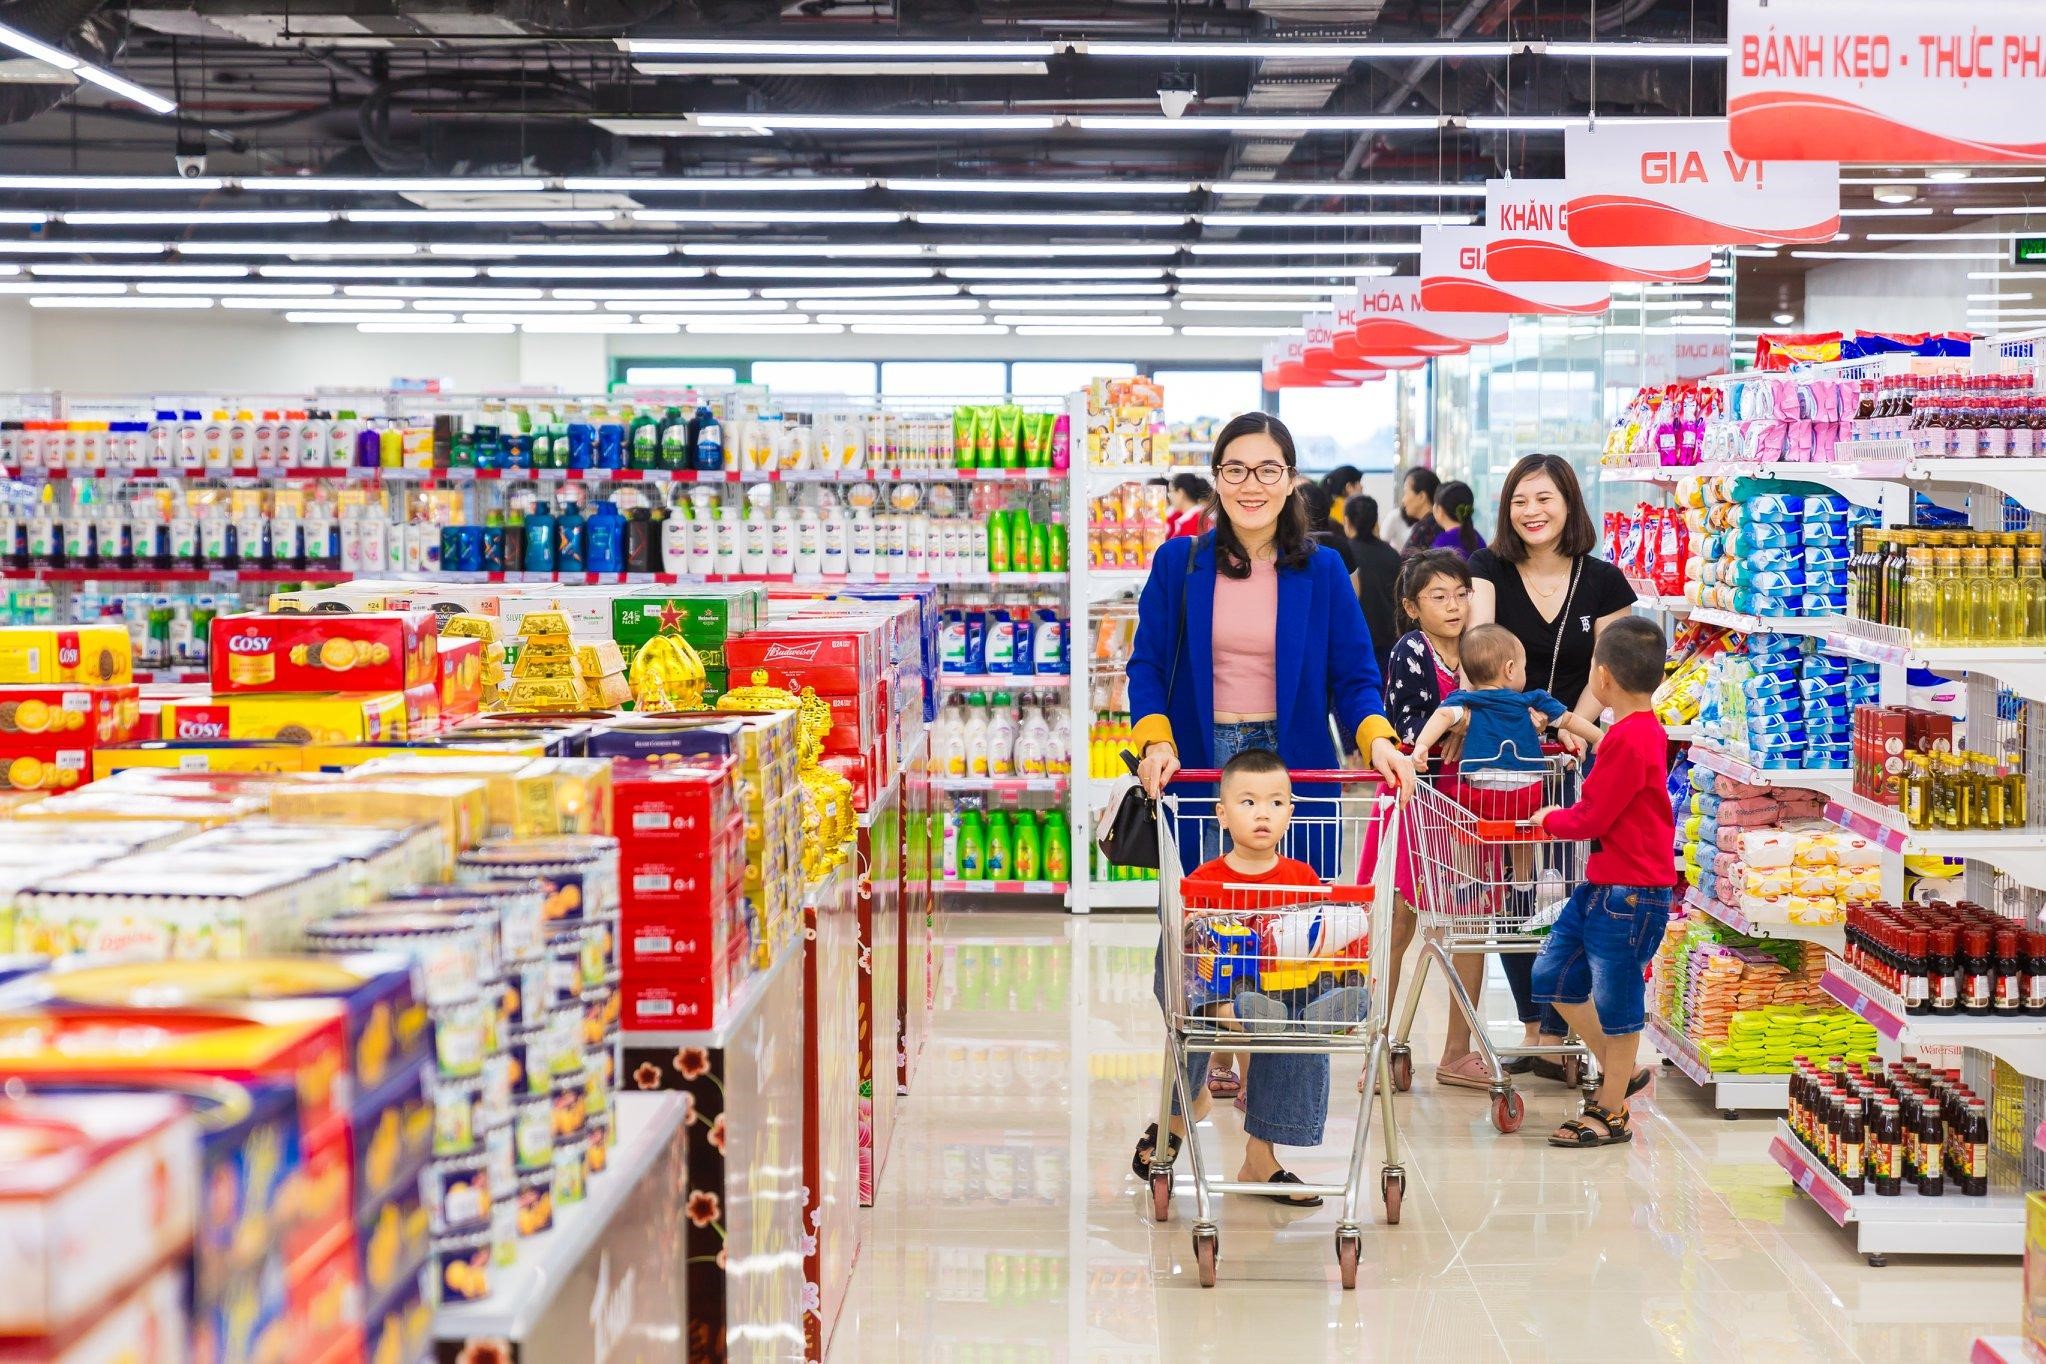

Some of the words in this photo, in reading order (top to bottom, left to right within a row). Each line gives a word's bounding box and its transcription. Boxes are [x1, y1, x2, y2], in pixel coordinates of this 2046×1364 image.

[1742, 26, 1824, 77] BÁNH
[1833, 35, 1890, 89] KẸO
[1918, 25, 1993, 89] THỰC
[2003, 35, 2046, 77] PH
[1641, 151, 1709, 184] GIA
[1500, 199, 1553, 231] KHĂN
[1460, 247, 1486, 270] GI
[1363, 289, 1404, 312] HÓA
[767, 646, 818, 657] Budweiser
